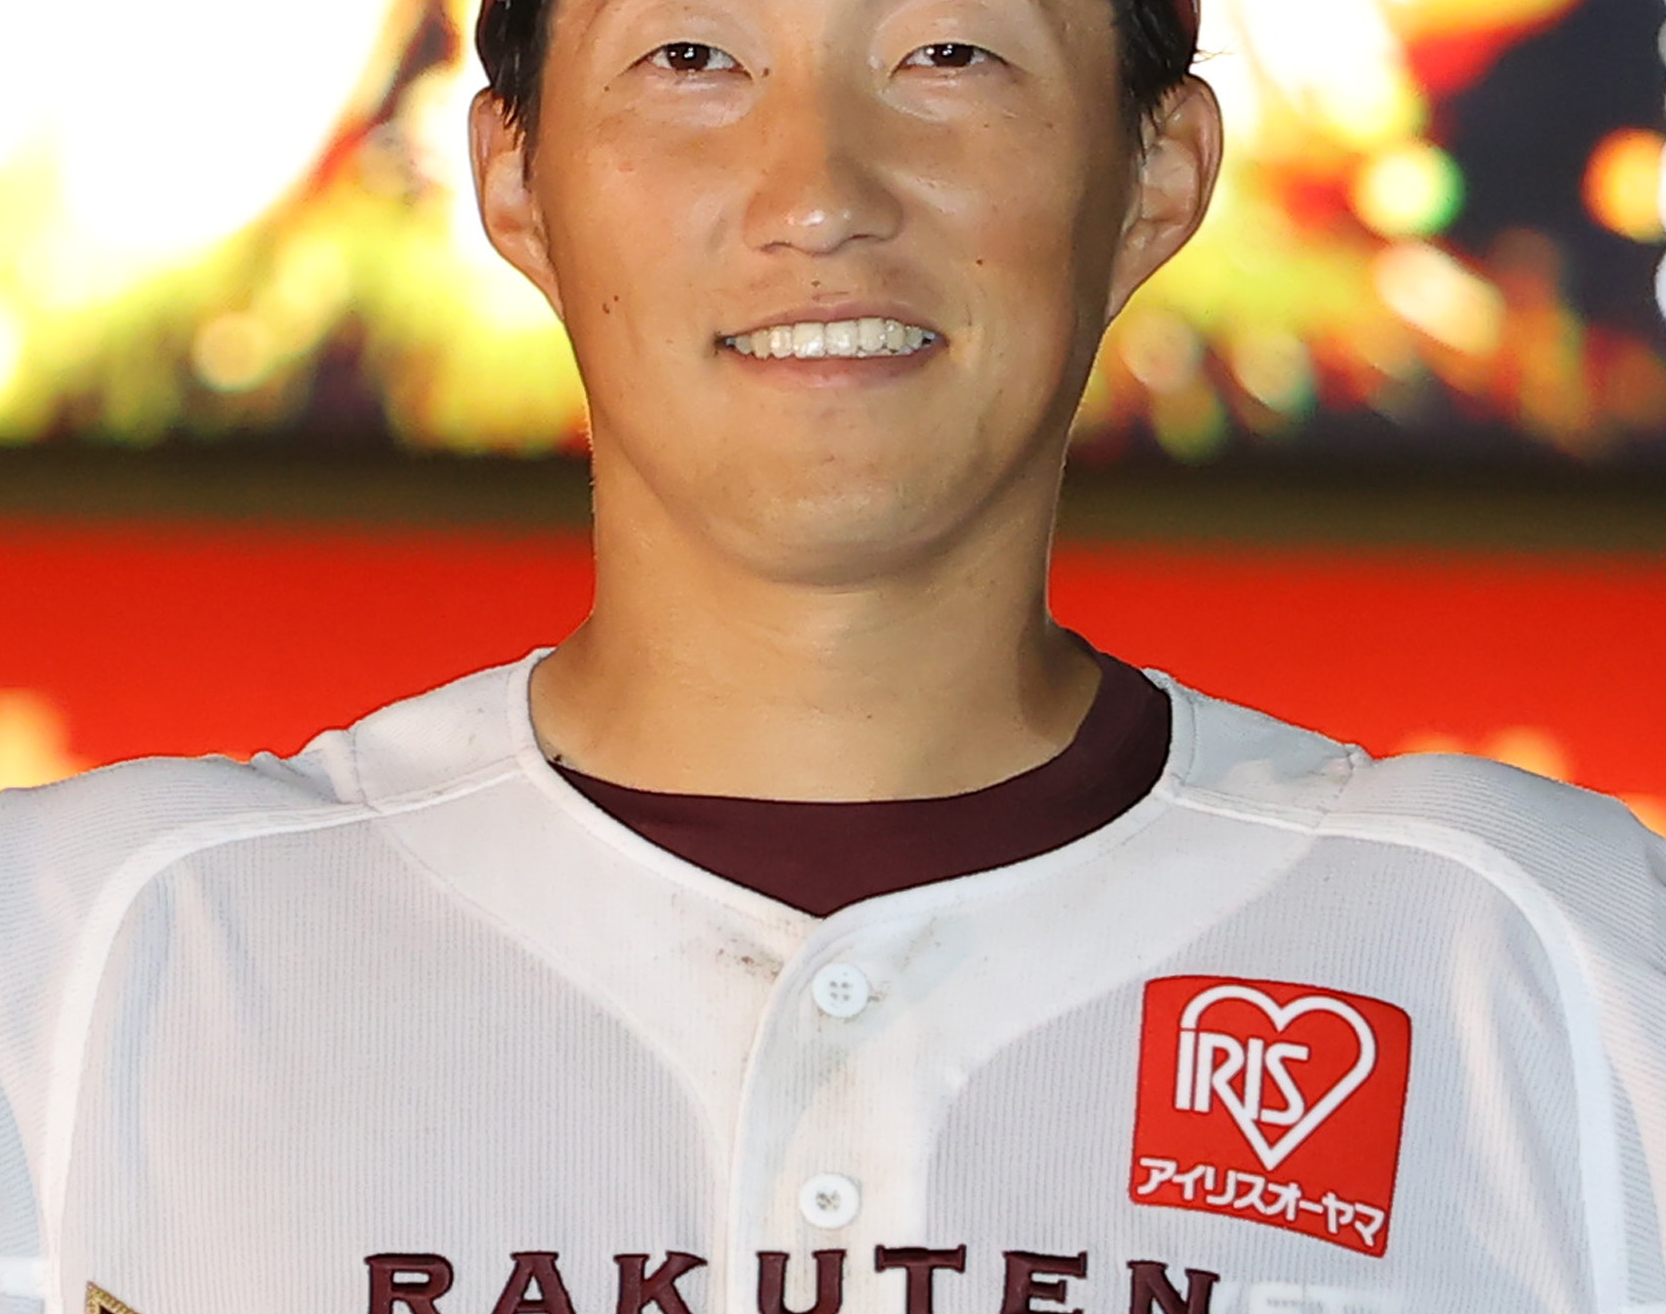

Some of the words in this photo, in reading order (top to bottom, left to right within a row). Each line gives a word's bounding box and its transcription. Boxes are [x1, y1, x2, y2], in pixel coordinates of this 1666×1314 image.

[1174, 1029, 1311, 1127] IRIS
[1136, 1157, 1387, 1248] アイリスオーヤマ
